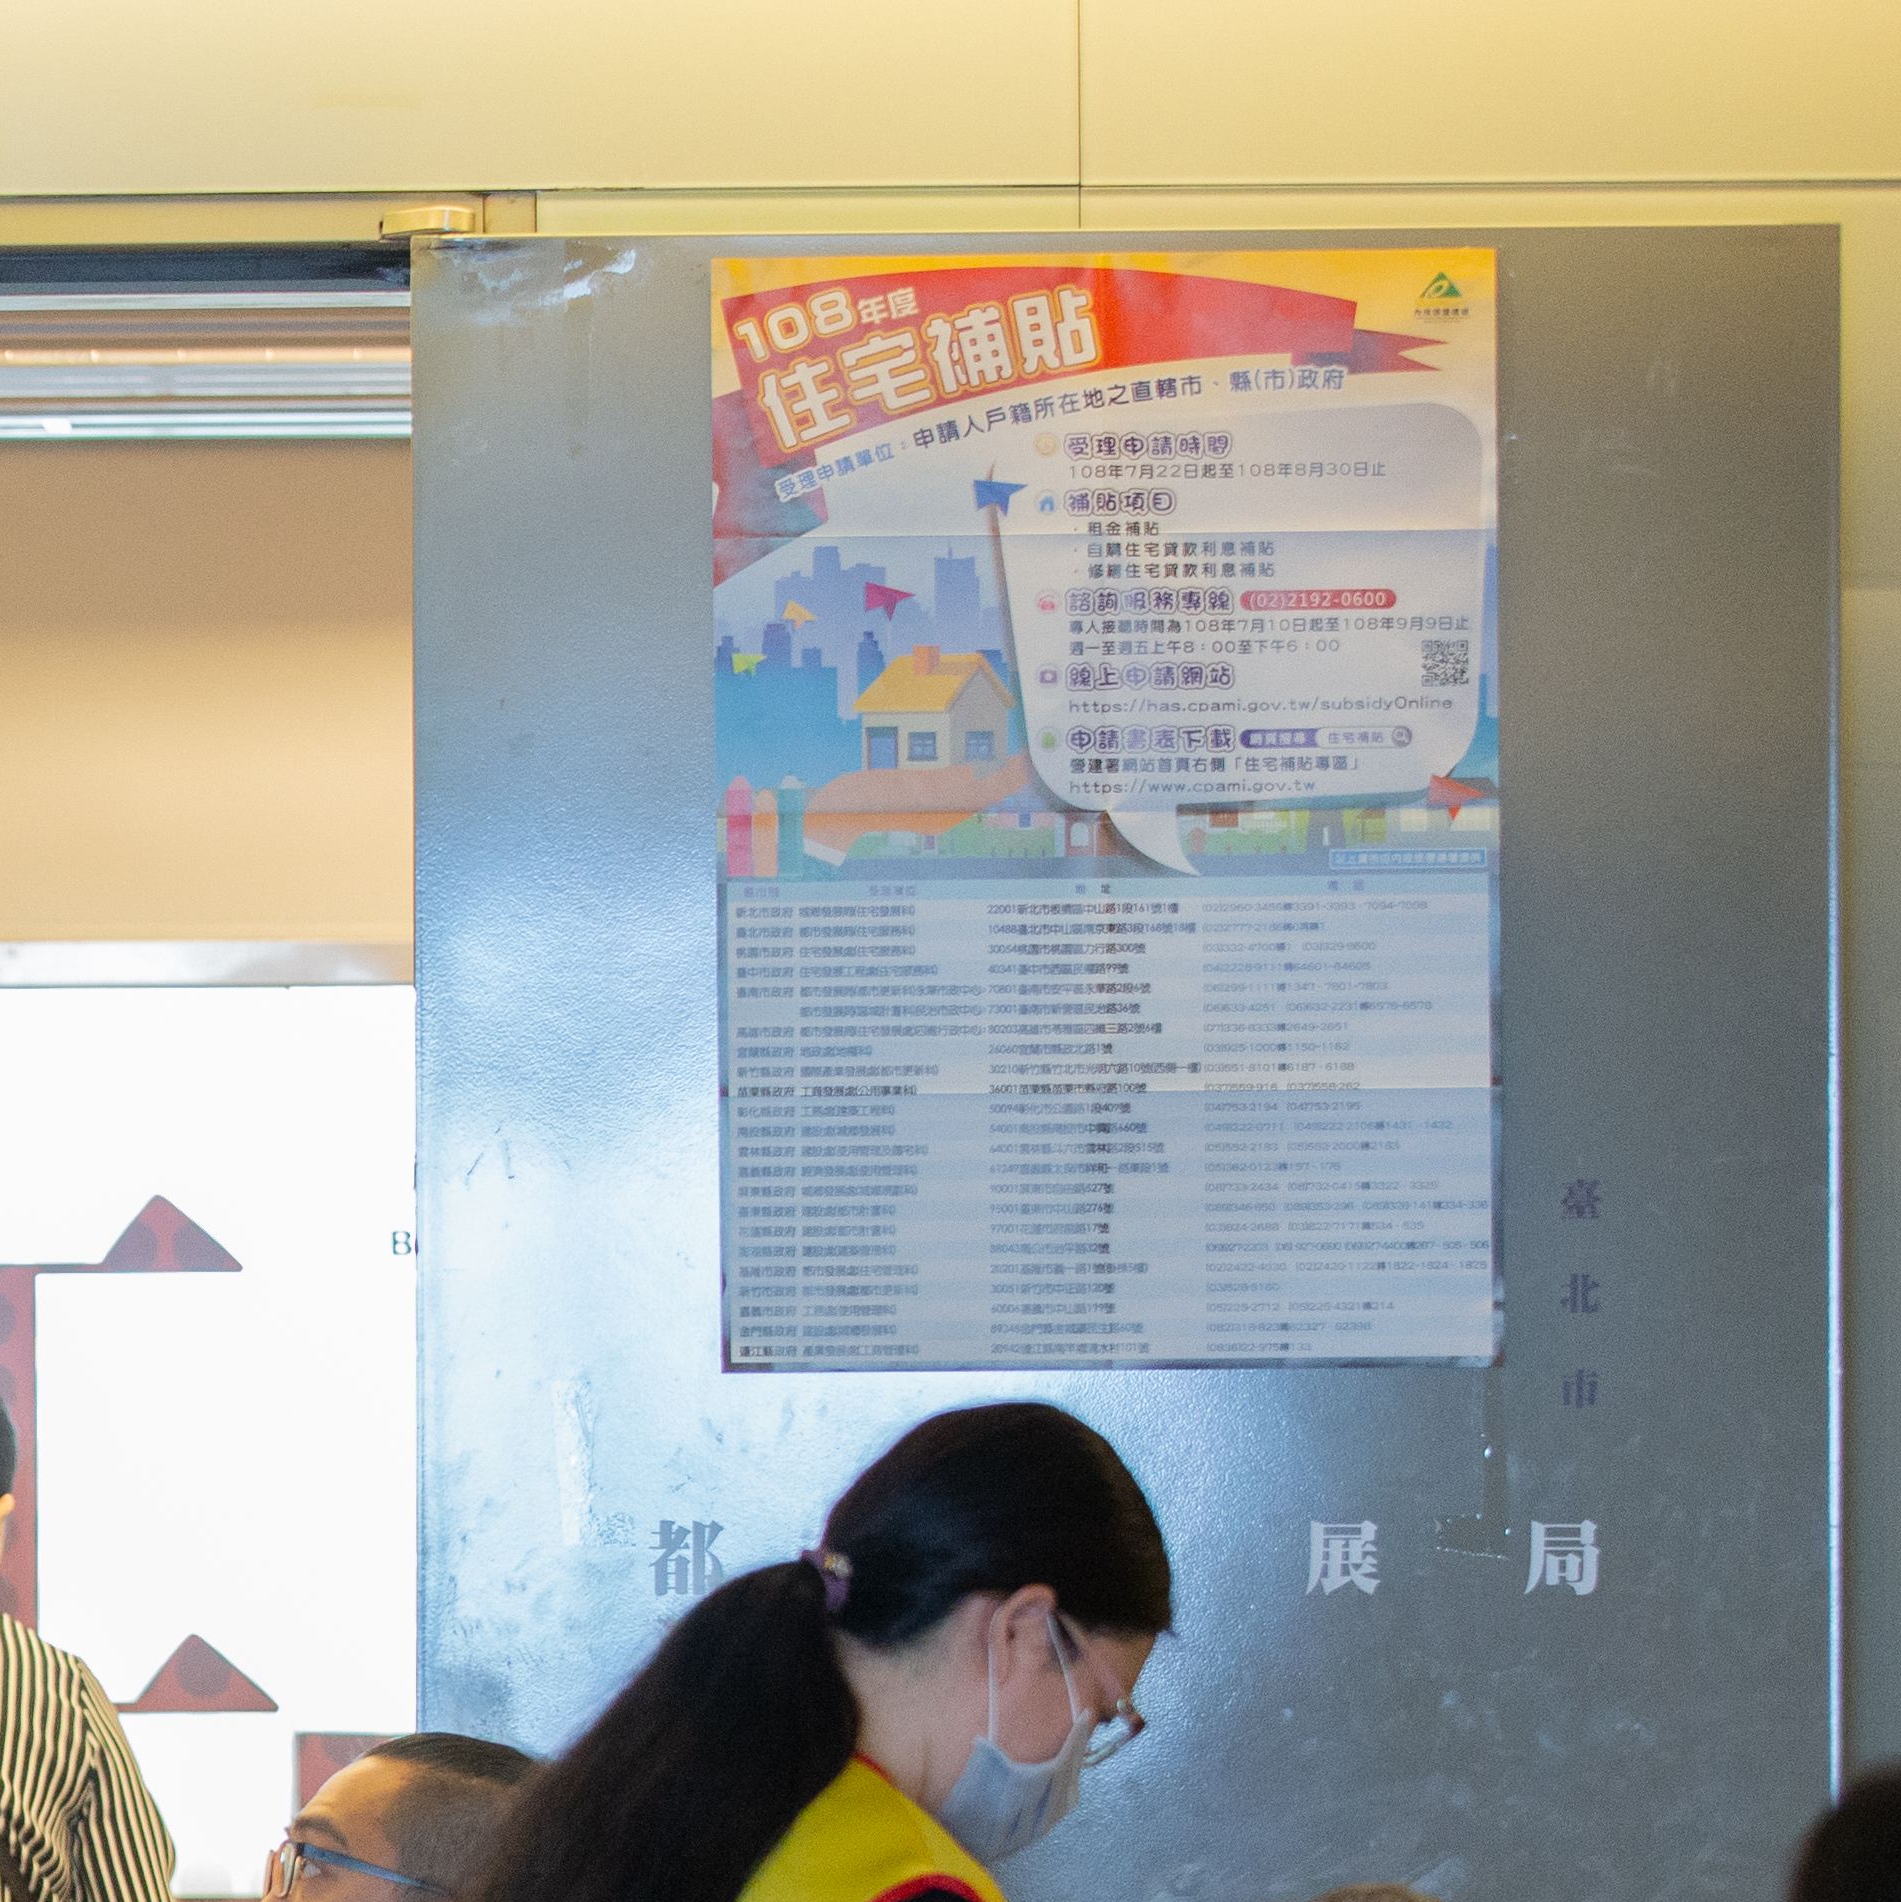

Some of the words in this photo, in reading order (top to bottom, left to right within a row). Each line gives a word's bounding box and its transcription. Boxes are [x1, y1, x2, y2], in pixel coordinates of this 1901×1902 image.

[734, 286, 919, 363] 108年度
[758, 285, 1101, 453] 住宅補貼
[1067, 434, 1229, 457] 受理申請時間
[1068, 460, 1386, 479] 108年7月22日起至108年8月30日止
[1068, 492, 1173, 514] 補貼項目
[1087, 521, 1159, 536] 租金補貼
[1068, 591, 1231, 613] 諮詢服務專線
[1249, 591, 1386, 609] (02)2192-0600
[1068, 665, 1232, 687] 線上申請網站
[1068, 696, 1453, 714] https://has.cpami.gov.tw/subsidyOnline
[1068, 728, 1234, 749] 申請書表下載
[1328, 732, 1384, 744] 住宅補貼
[1069, 779, 1315, 794] https://www.cpami.gov.tw
[1561, 1179, 1597, 1410] 臺北市
